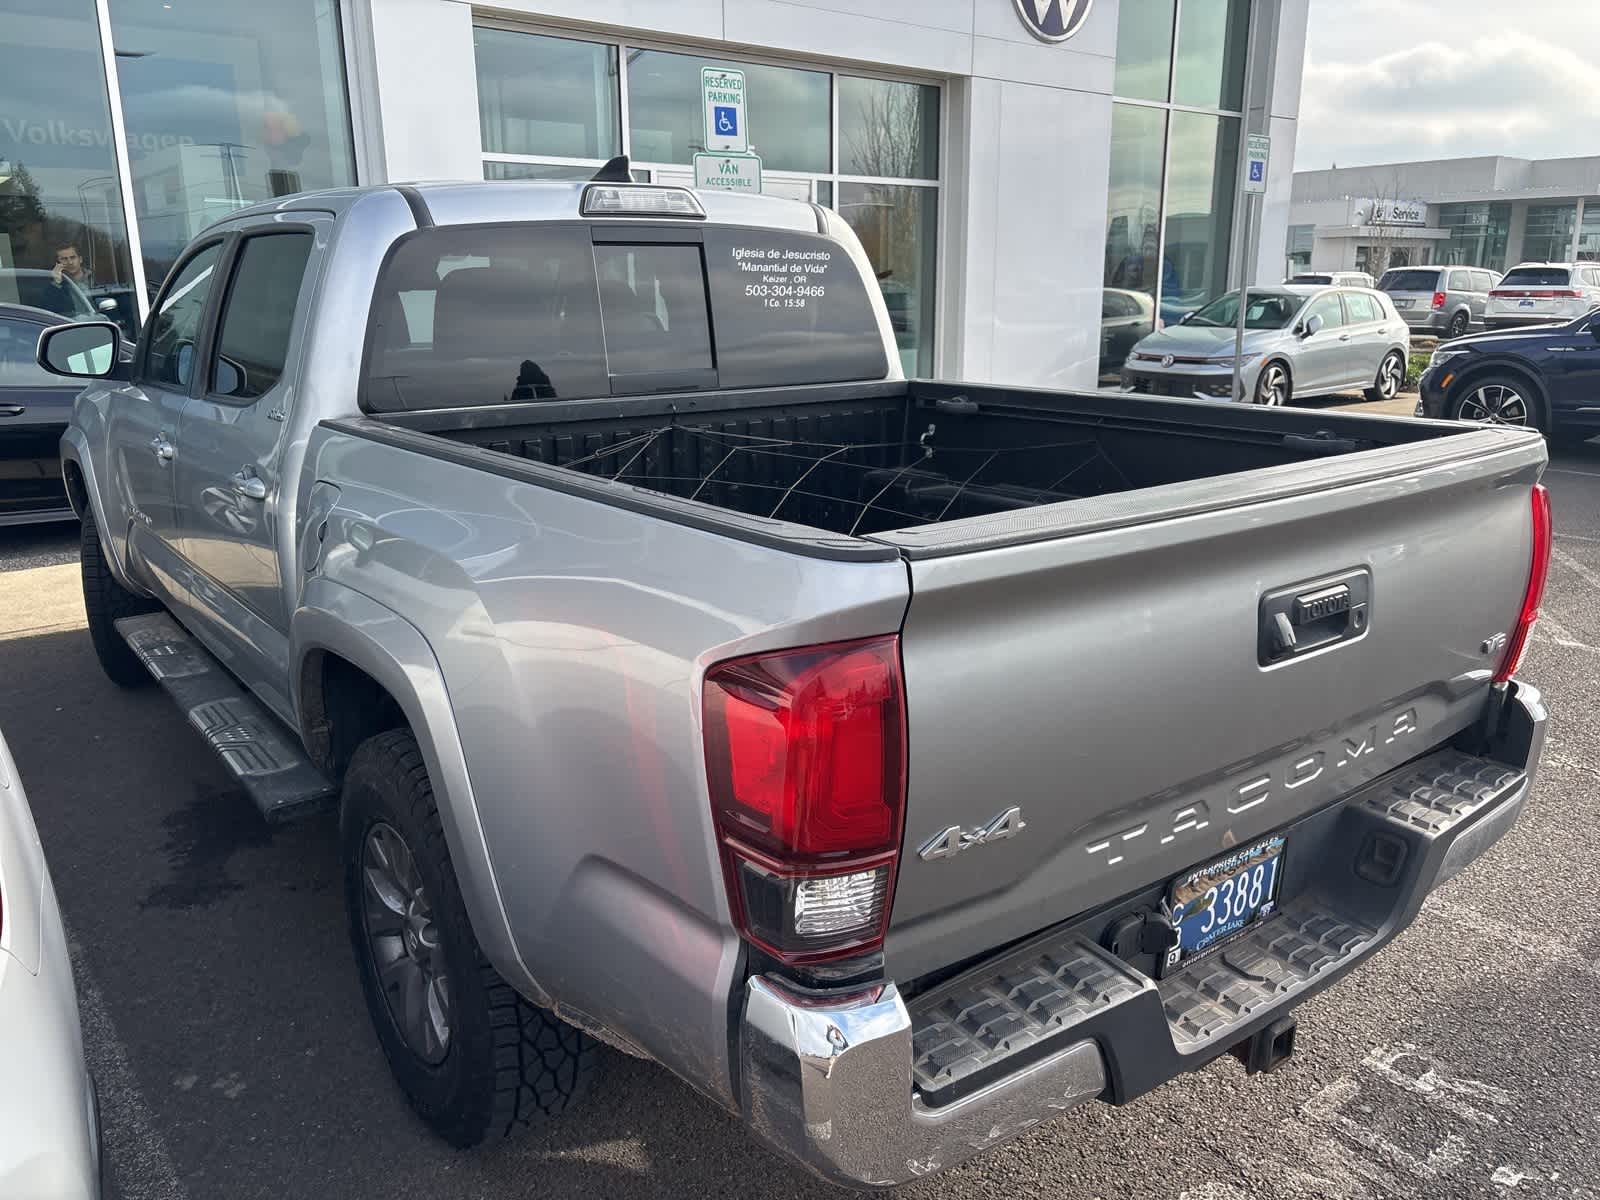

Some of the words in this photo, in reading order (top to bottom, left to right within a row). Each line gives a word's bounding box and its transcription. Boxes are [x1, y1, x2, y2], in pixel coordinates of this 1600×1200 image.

[704, 76, 742, 90] RESERVED
[708, 91, 741, 104] PARKING
[719, 163, 738, 175] VAN
[706, 177, 752, 187] ACCESSIBLE
[1393, 207, 1419, 220] Service
[732, 247, 765, 260] Iglesia
[767, 248, 780, 259] de
[782, 249, 831, 261] Jesucristo
[790, 263, 802, 273] de
[793, 275, 807, 283] OR
[745, 285, 825, 297] 503-304-9466
[784, 299, 806, 308] 15:58
[1085, 707, 1418, 865] TACOMA
[1187, 856, 1237, 883] ENTERPRISE
[1238, 847, 1258, 860] CAR
[1259, 836, 1279, 851] SALES
[1200, 856, 1278, 933] 33881
[1227, 918, 1245, 931] LAKE
